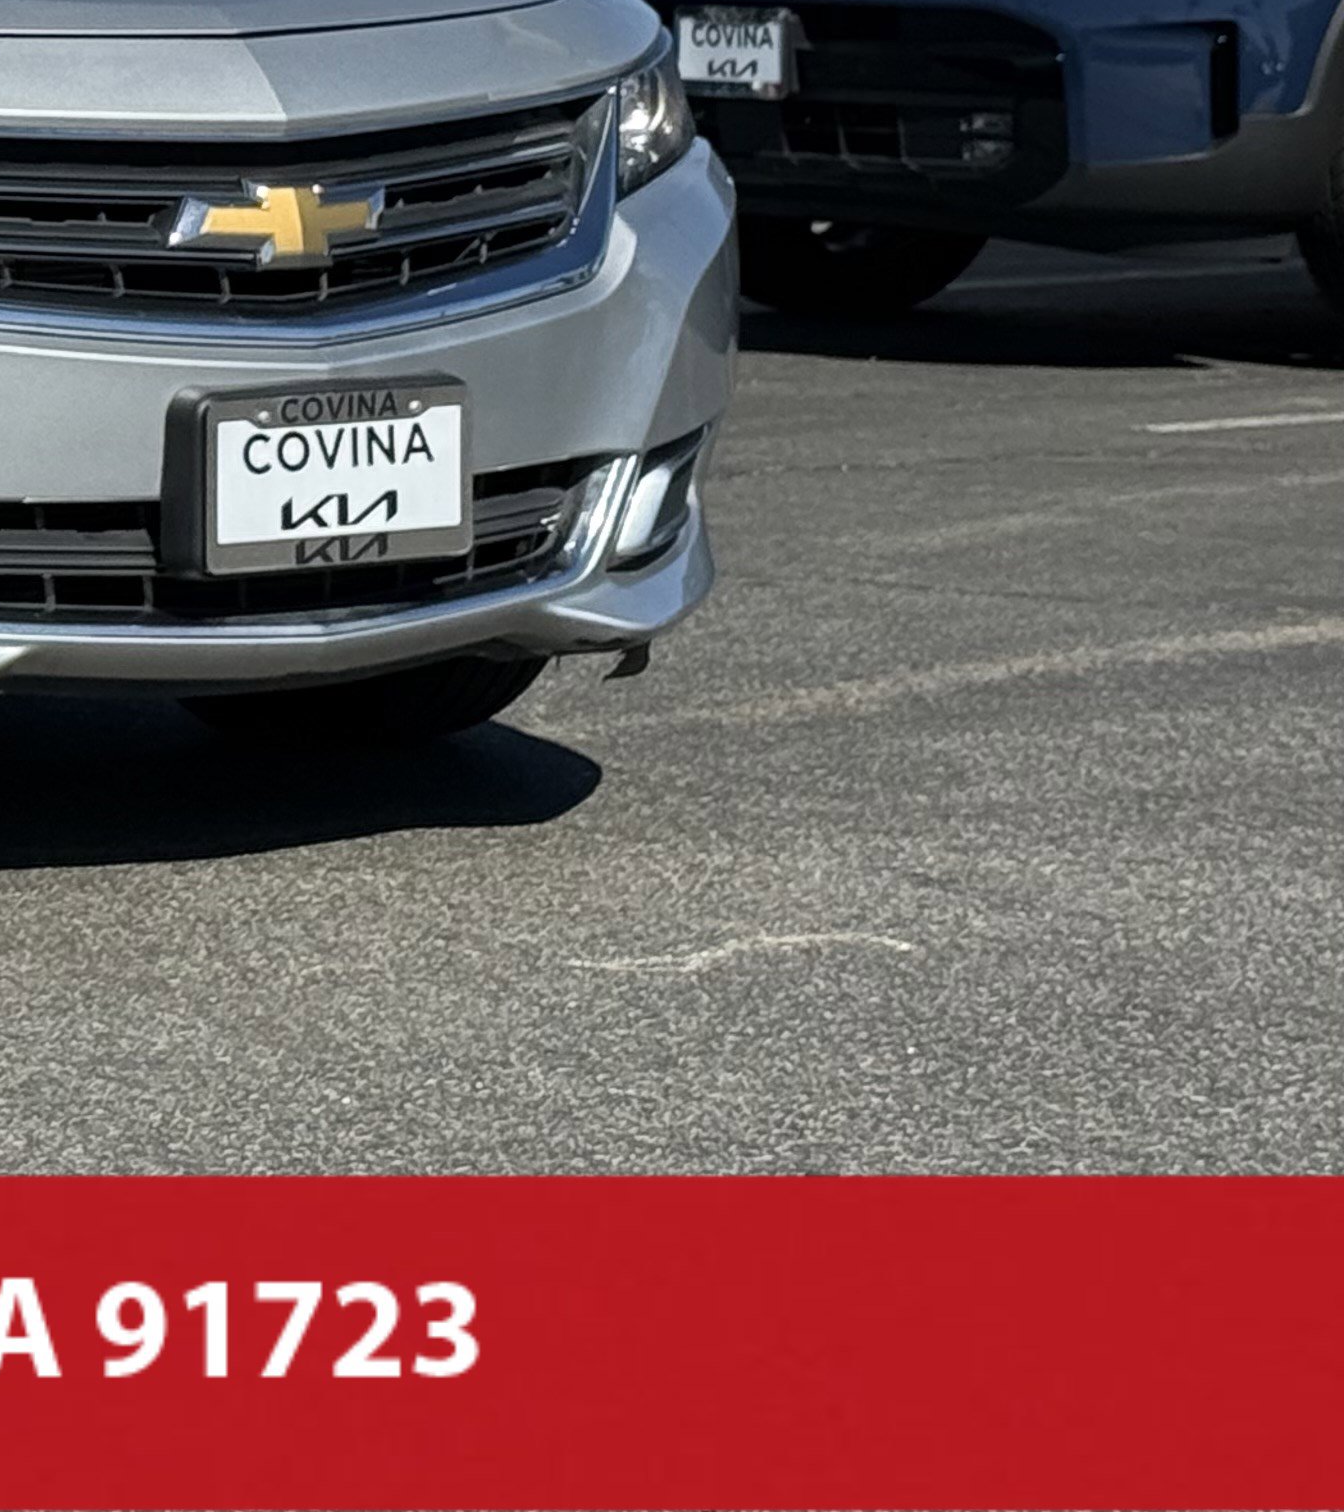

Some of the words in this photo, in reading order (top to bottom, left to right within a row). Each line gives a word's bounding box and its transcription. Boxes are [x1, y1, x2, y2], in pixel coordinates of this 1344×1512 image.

[691, 22, 774, 50] COVINA
[279, 391, 399, 424] COVINA
[242, 422, 435, 475] COVINA
